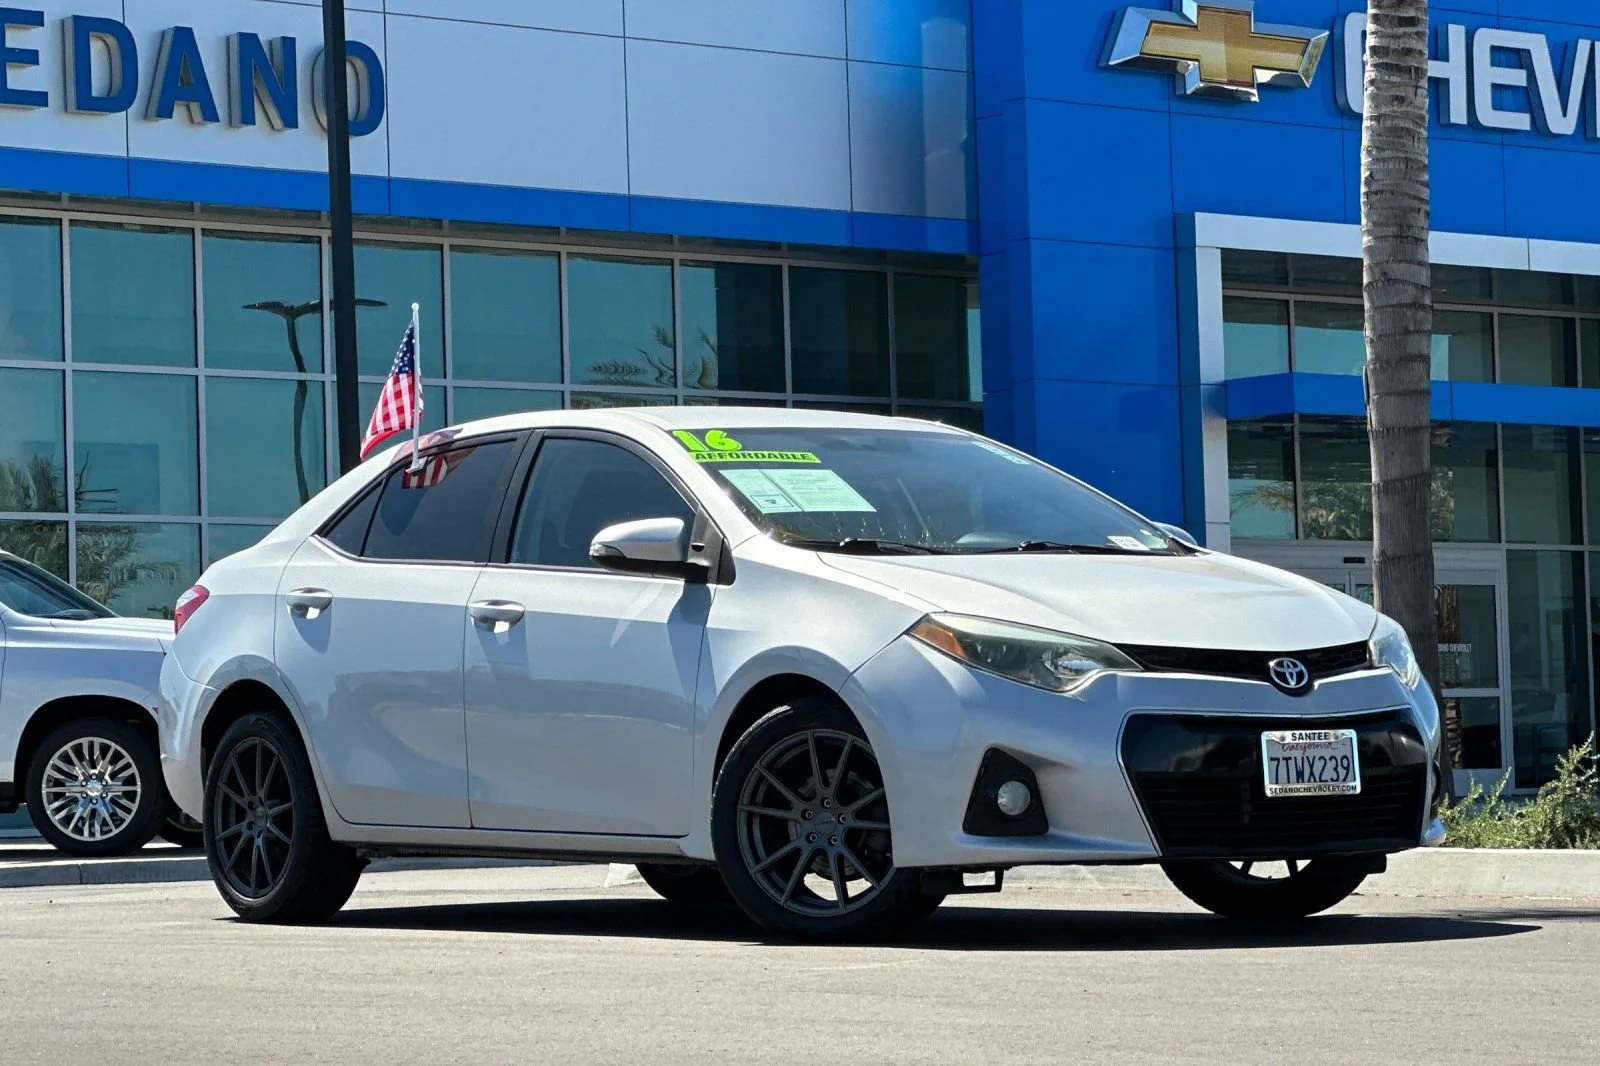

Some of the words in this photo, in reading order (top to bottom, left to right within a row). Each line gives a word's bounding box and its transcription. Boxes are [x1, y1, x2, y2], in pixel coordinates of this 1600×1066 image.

[672, 429, 742, 451] 16
[695, 452, 812, 461] AFFORDABLE
[1291, 732, 1329, 741] SANTEE
[1269, 755, 1351, 784] 7TWX239
[1269, 785, 1357, 795] SEDANOCHEVROLET.COM
